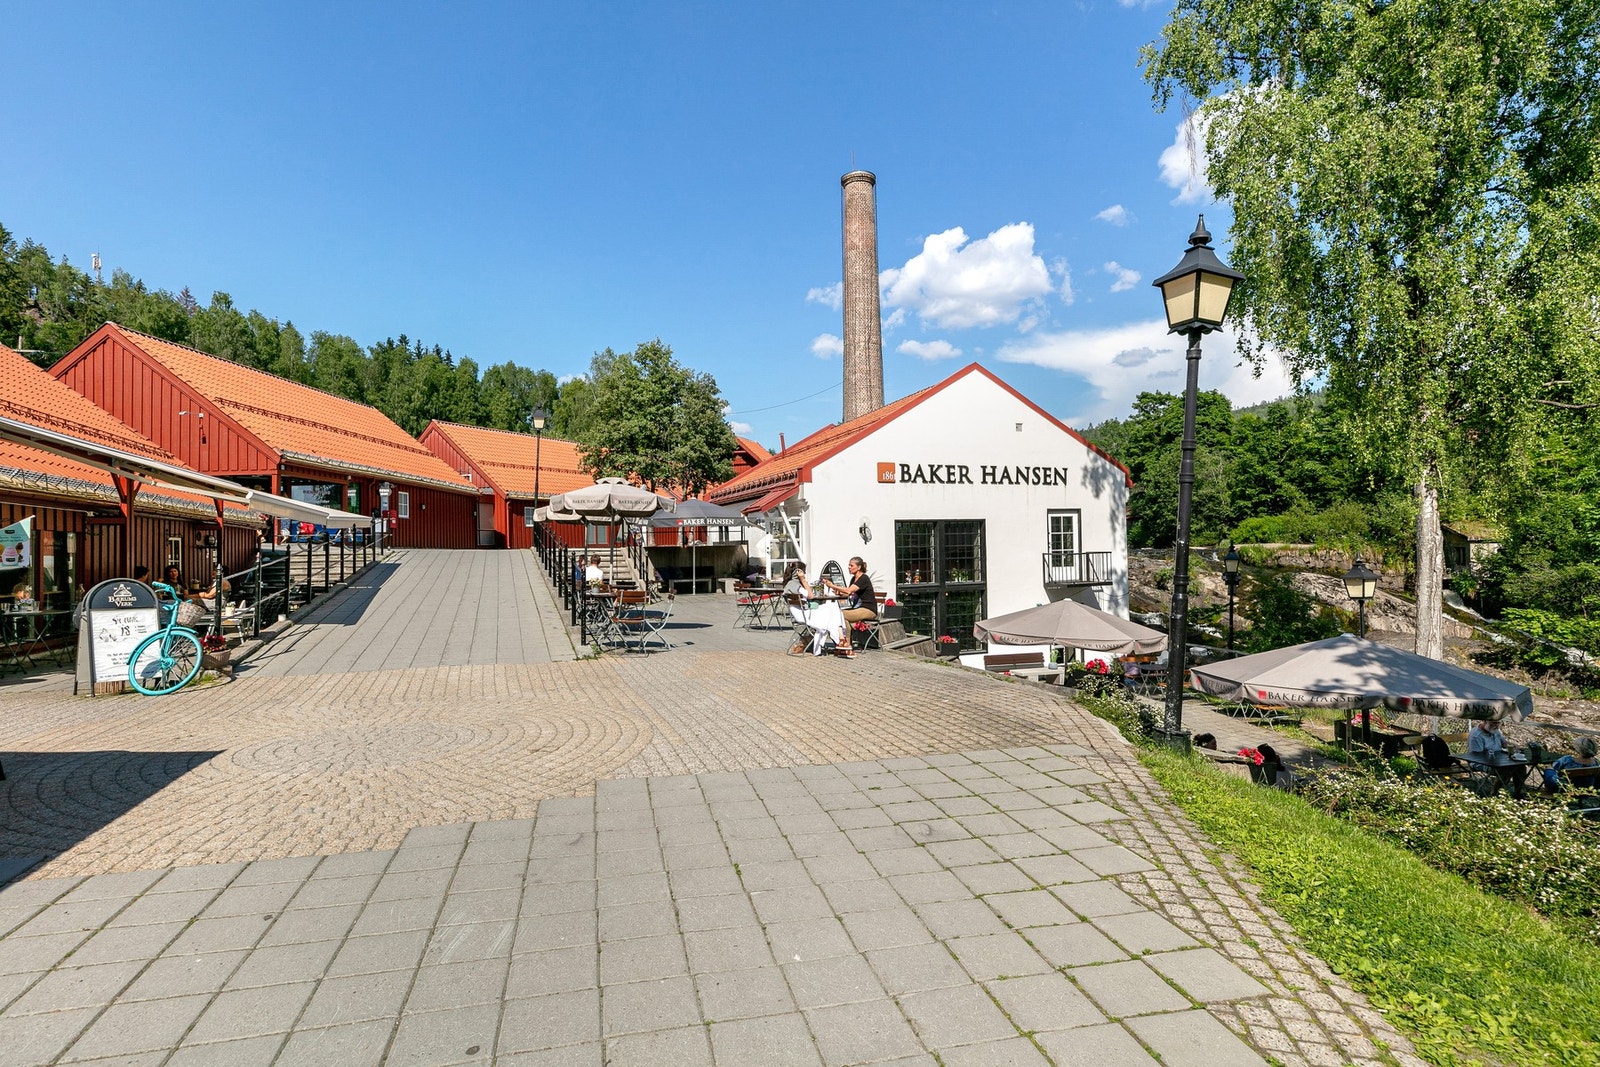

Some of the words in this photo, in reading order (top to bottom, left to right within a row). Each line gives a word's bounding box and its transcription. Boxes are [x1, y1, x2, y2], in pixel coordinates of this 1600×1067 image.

[899, 463, 973, 484] BAKER
[980, 465, 1068, 486] HANSEN
[683, 518, 705, 526] BAKER
[706, 517, 735, 525] HANSEN
[1268, 691, 1305, 702] BAKER
[1310, 695, 1364, 703] HANSEN
[1412, 698, 1450, 710] BAKER
[1454, 702, 1500, 714] HANSEN
